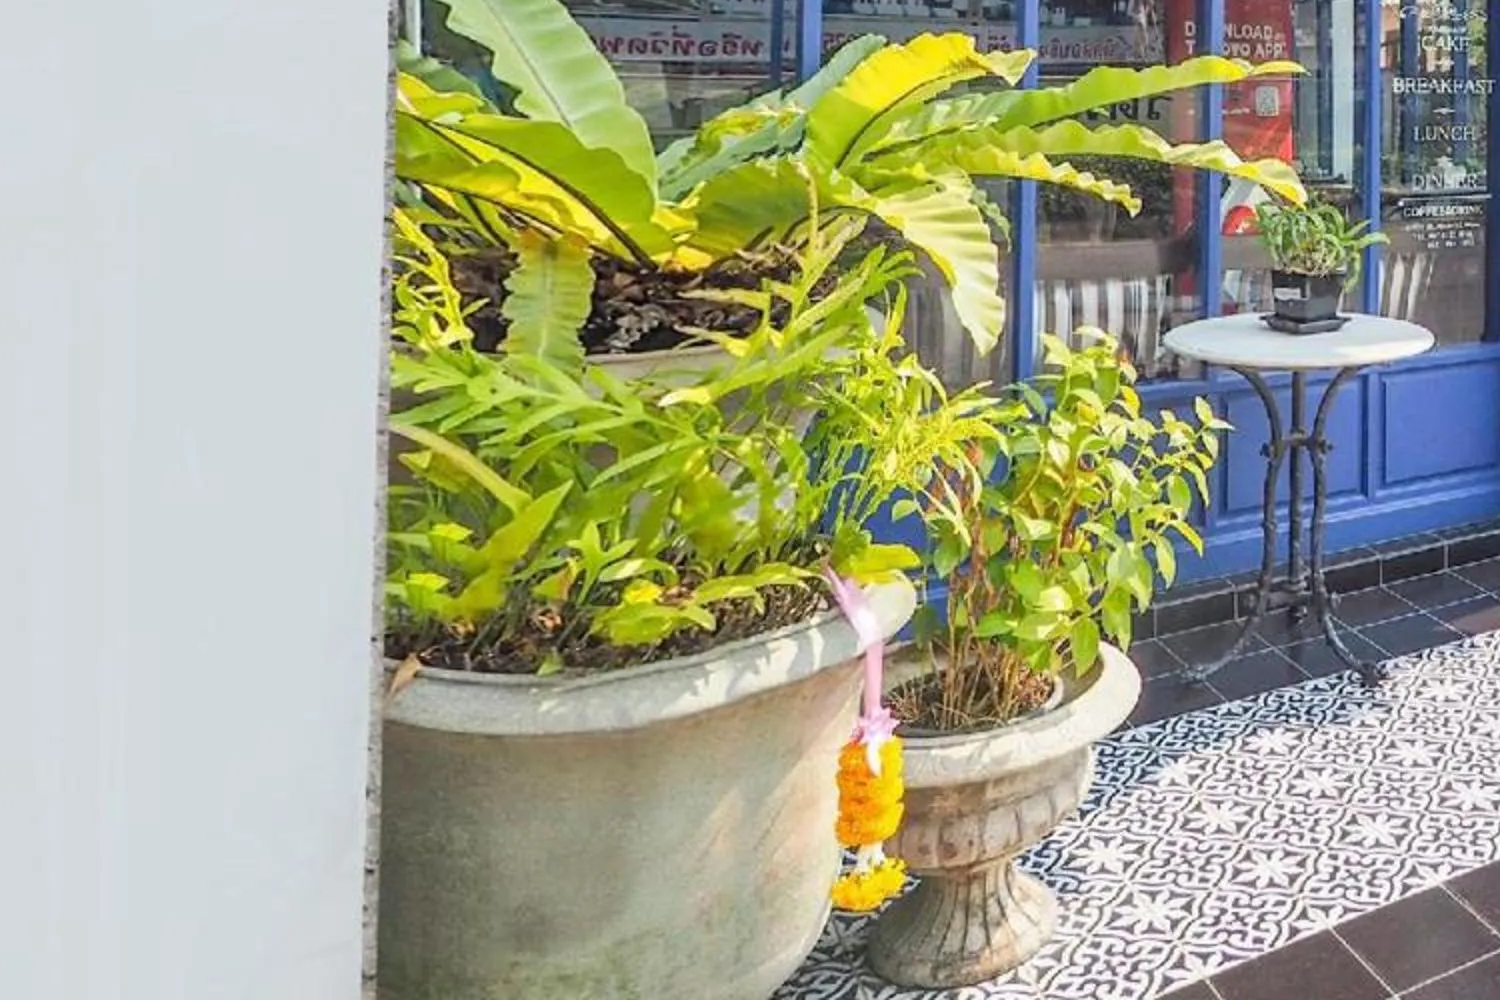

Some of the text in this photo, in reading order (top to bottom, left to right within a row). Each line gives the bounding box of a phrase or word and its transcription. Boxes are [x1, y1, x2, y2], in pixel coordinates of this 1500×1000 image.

[1184, 21, 1273, 41] DNLOAD
[1392, 77, 1496, 94] BREAKFAST
[1413, 124, 1475, 142] LUNCH
